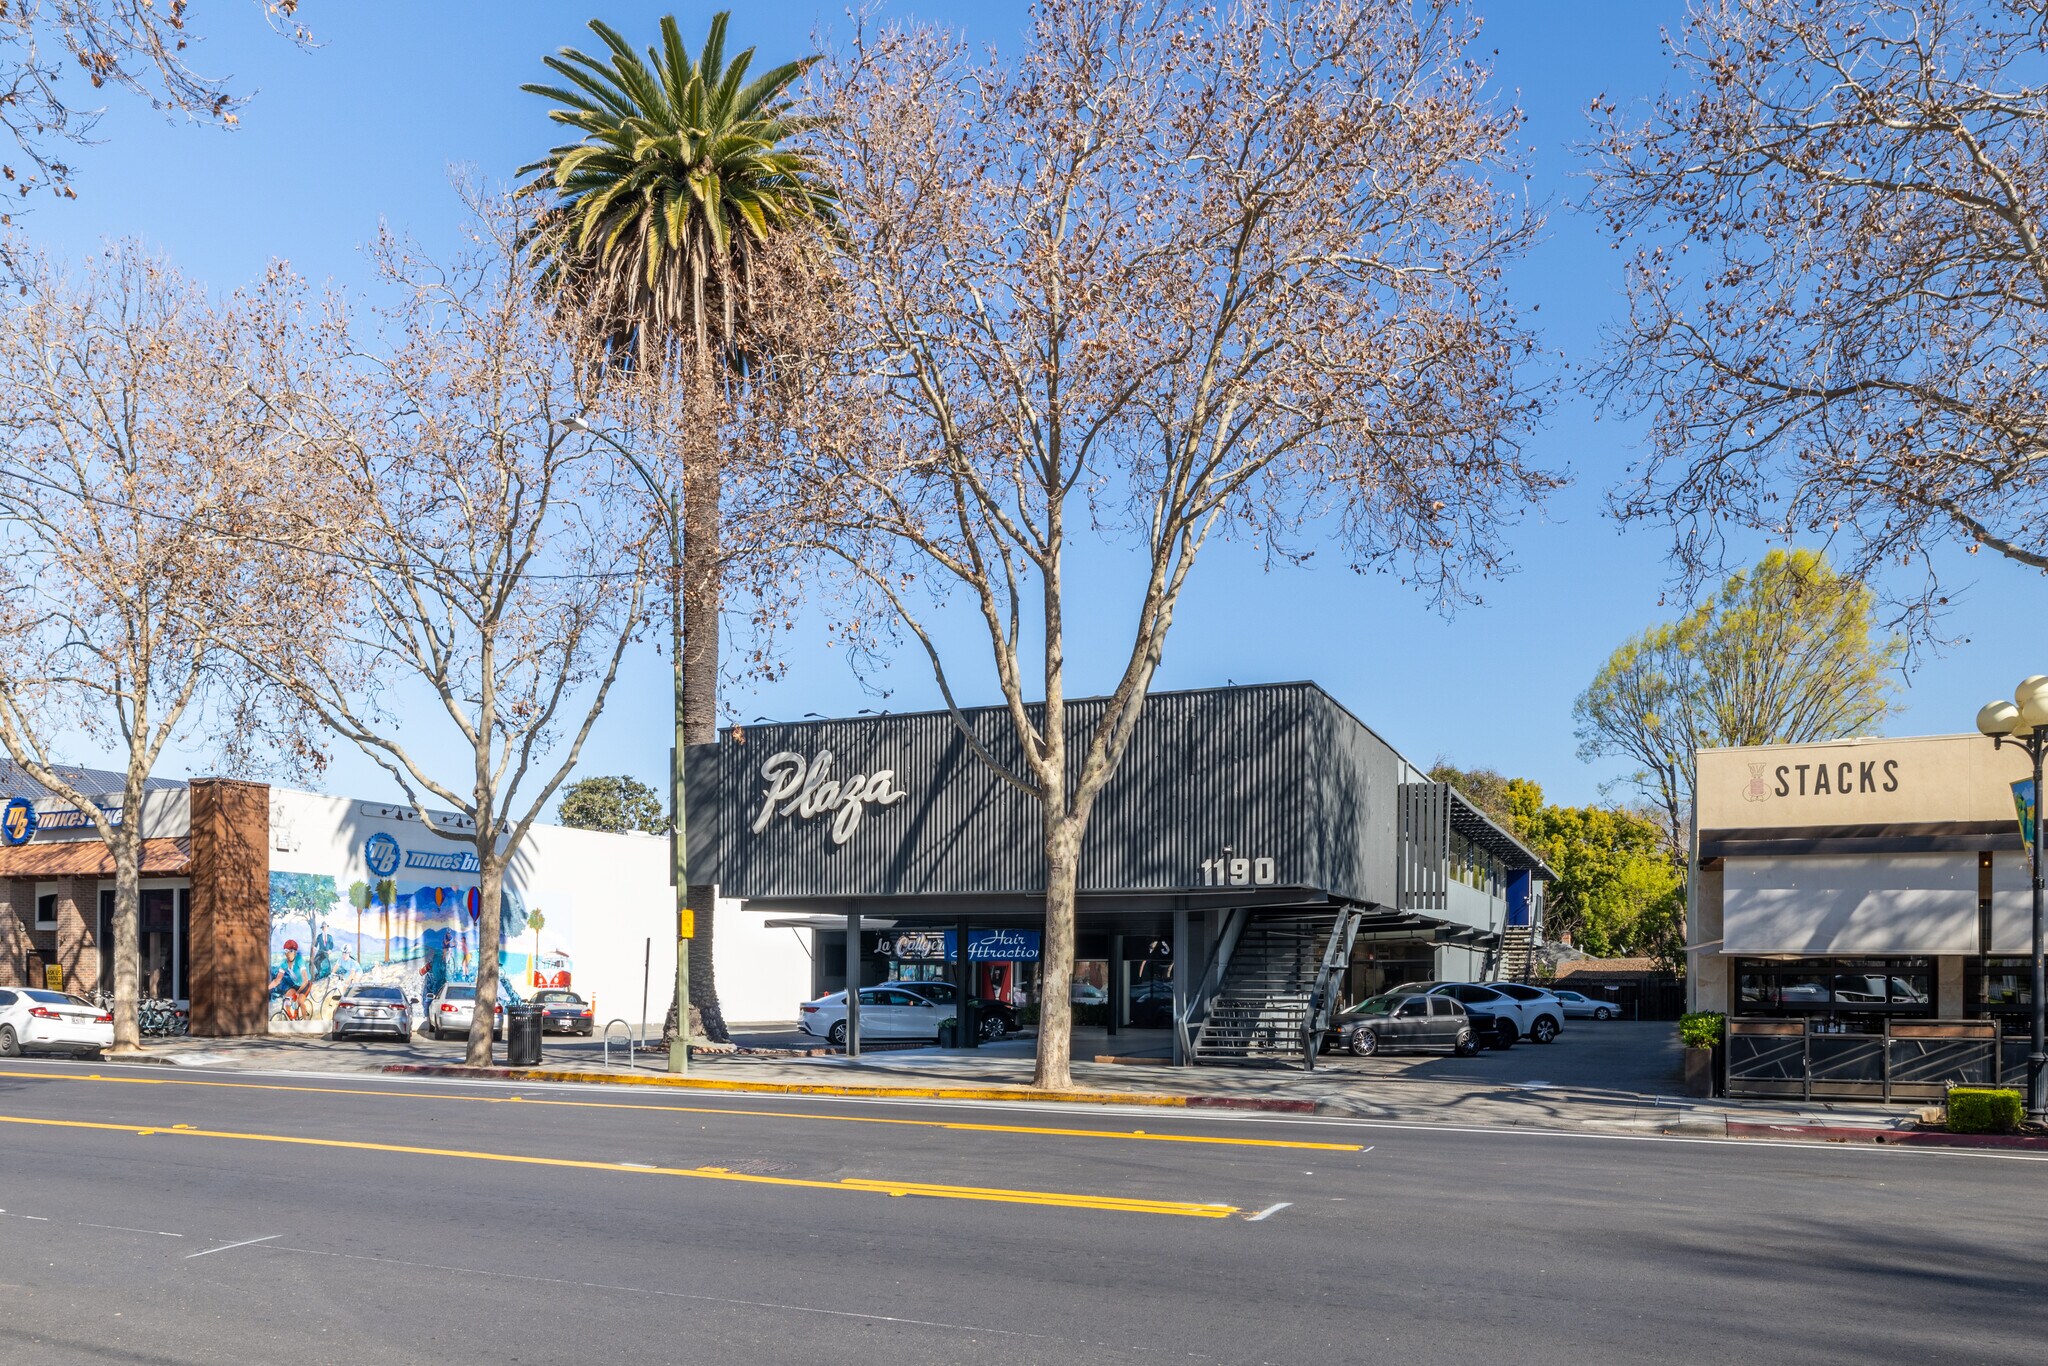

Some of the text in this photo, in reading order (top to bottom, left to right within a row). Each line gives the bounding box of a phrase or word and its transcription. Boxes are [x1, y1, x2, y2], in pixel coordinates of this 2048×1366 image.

[1775, 759, 1899, 798] STACKS
[752, 750, 907, 845] Plaza
[1201, 857, 1275, 886] 1190
[874, 938, 891, 955] La
[981, 930, 1026, 946] Hair
